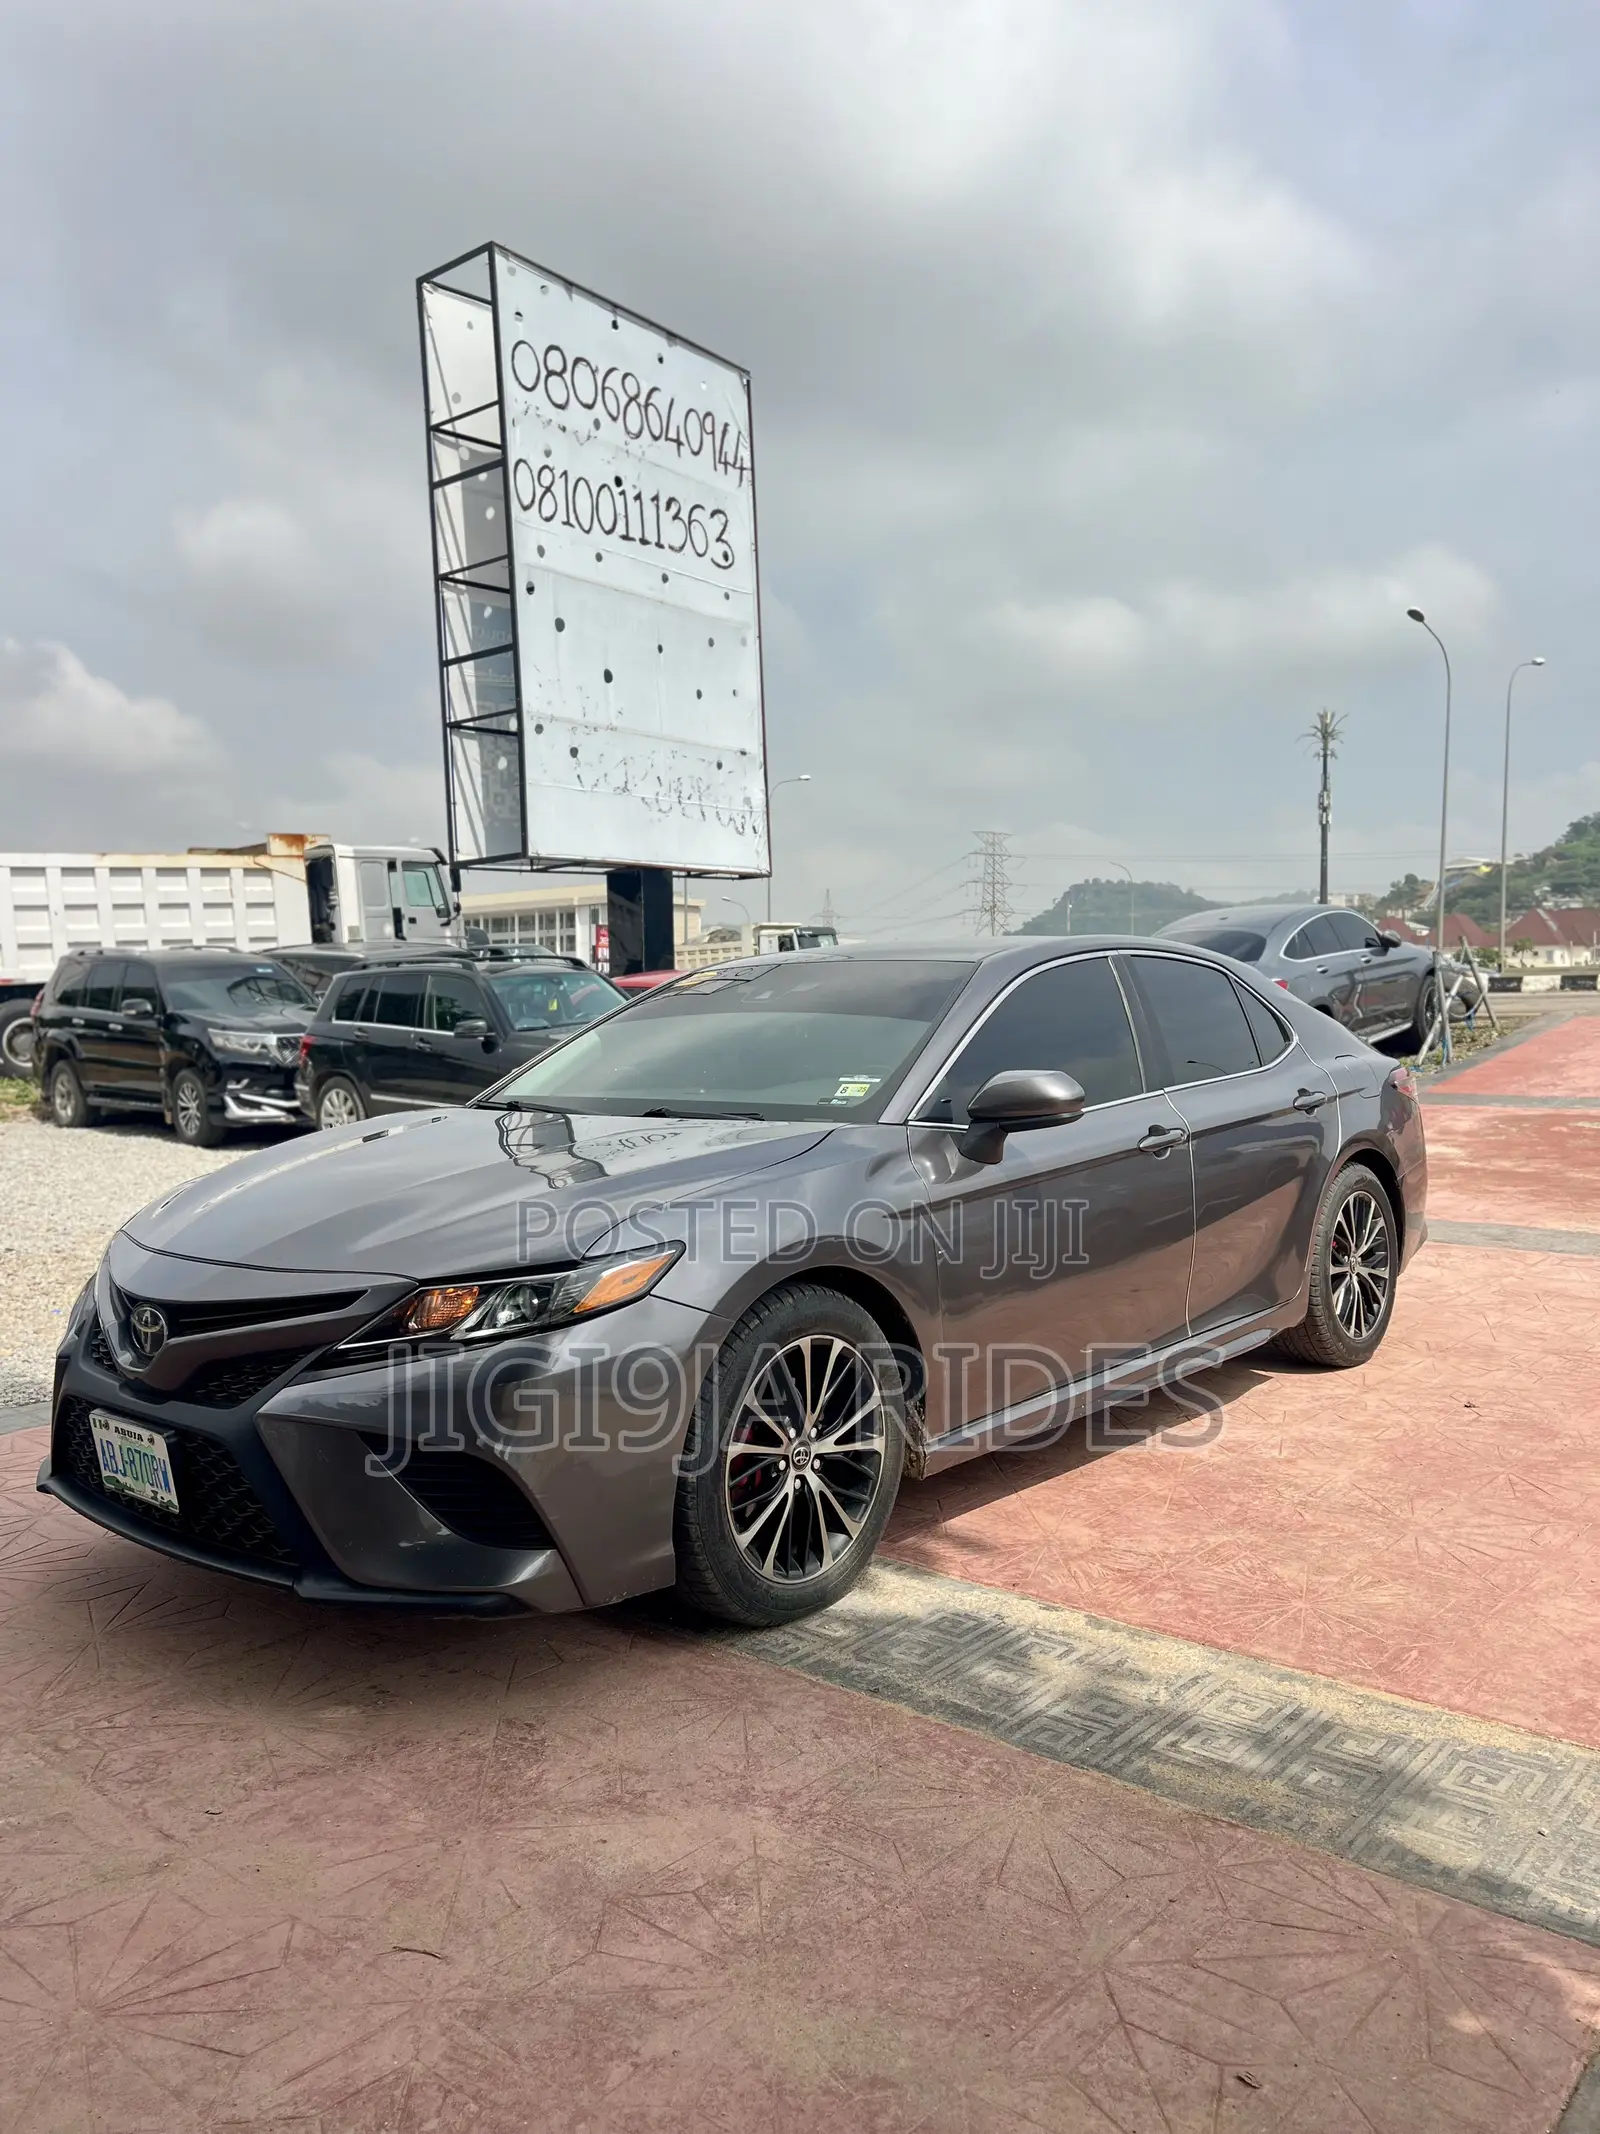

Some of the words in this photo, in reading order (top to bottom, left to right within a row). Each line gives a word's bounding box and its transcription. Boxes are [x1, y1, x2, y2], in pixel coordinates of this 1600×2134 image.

[511, 340, 752, 487] 08068640944
[513, 458, 735, 569] 08100111363
[114, 1425, 144, 1442] ABUJA
